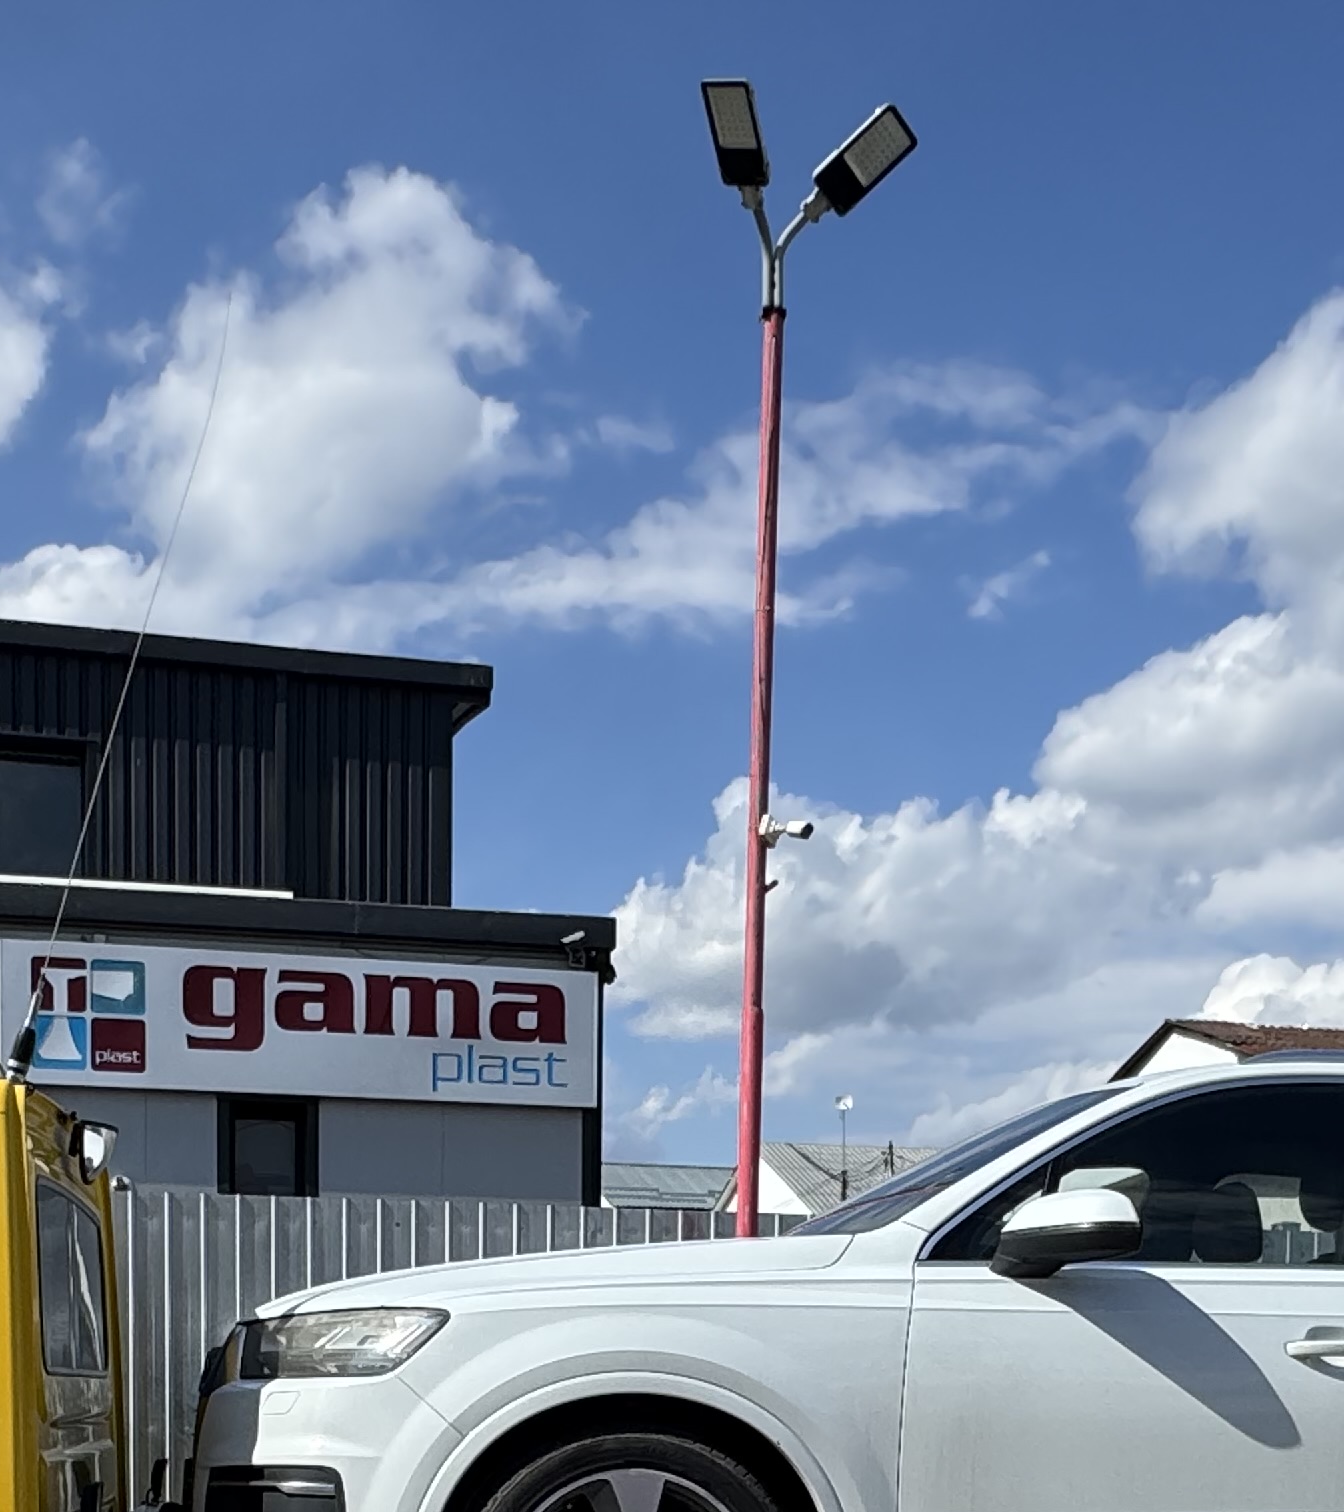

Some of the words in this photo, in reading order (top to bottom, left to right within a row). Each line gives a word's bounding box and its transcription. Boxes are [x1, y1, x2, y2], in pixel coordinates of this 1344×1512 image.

[182, 963, 567, 1052] gama
[95, 1048, 142, 1066] plast
[432, 1044, 569, 1092] plast
